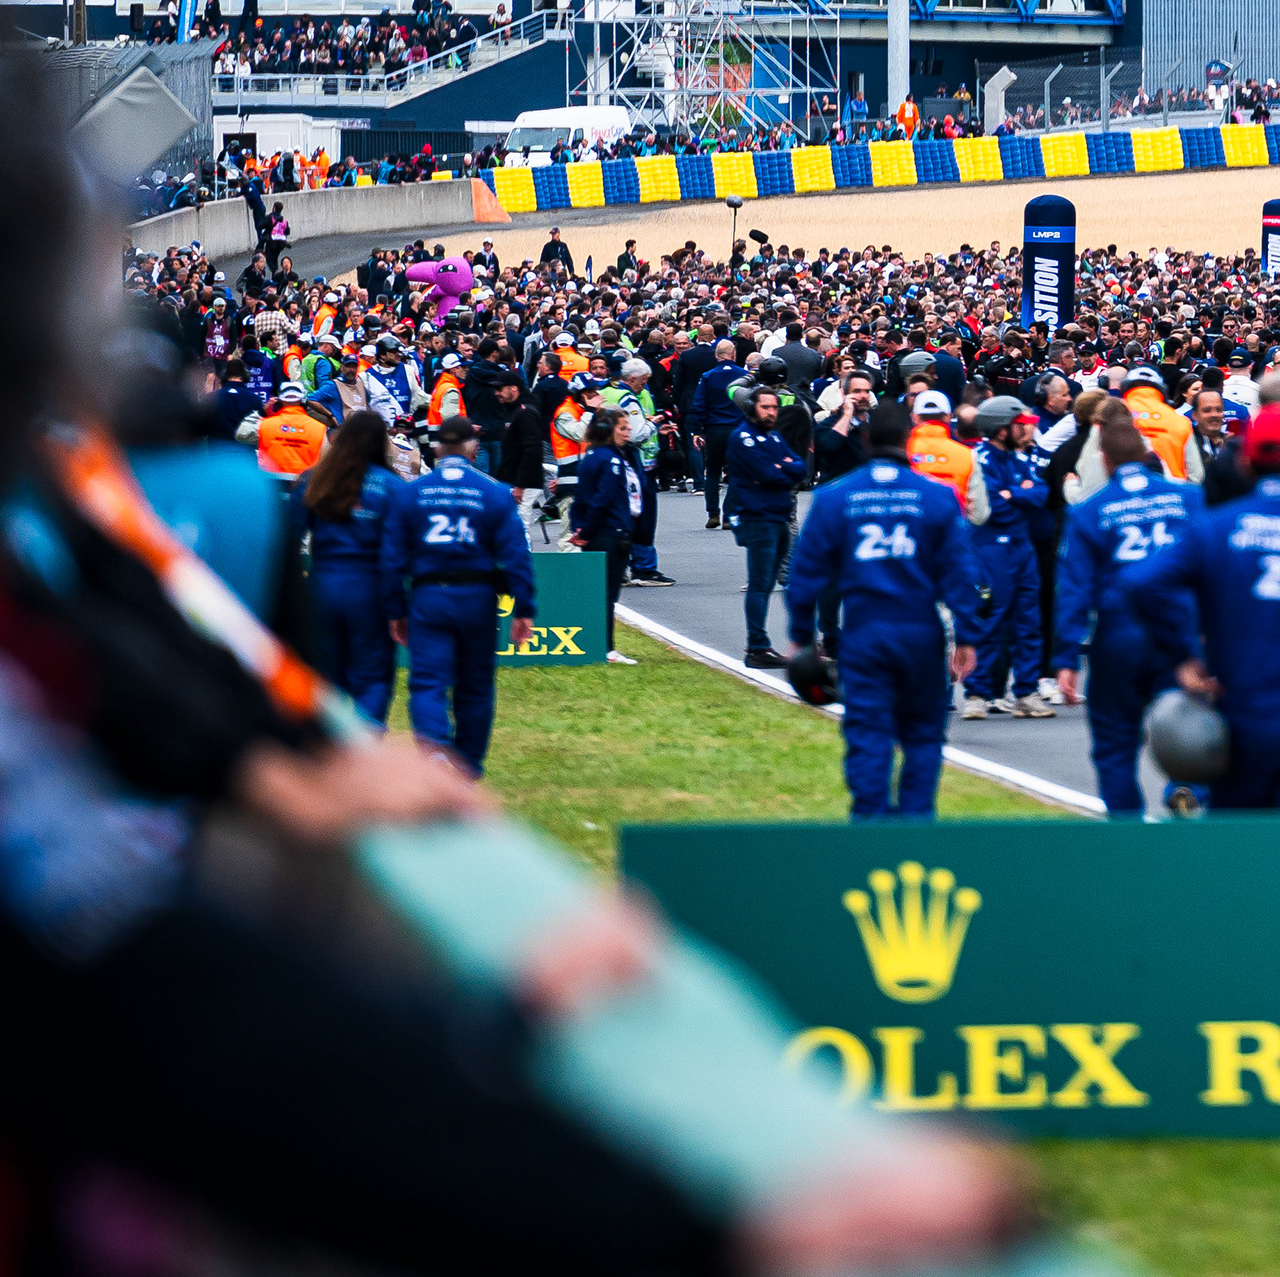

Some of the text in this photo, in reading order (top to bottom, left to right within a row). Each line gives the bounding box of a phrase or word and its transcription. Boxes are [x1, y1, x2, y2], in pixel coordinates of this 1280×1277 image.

[1032, 231, 1061, 239] LMP2
[1033, 256, 1059, 337] SITION
[782, 1024, 1149, 1110] OLEX
